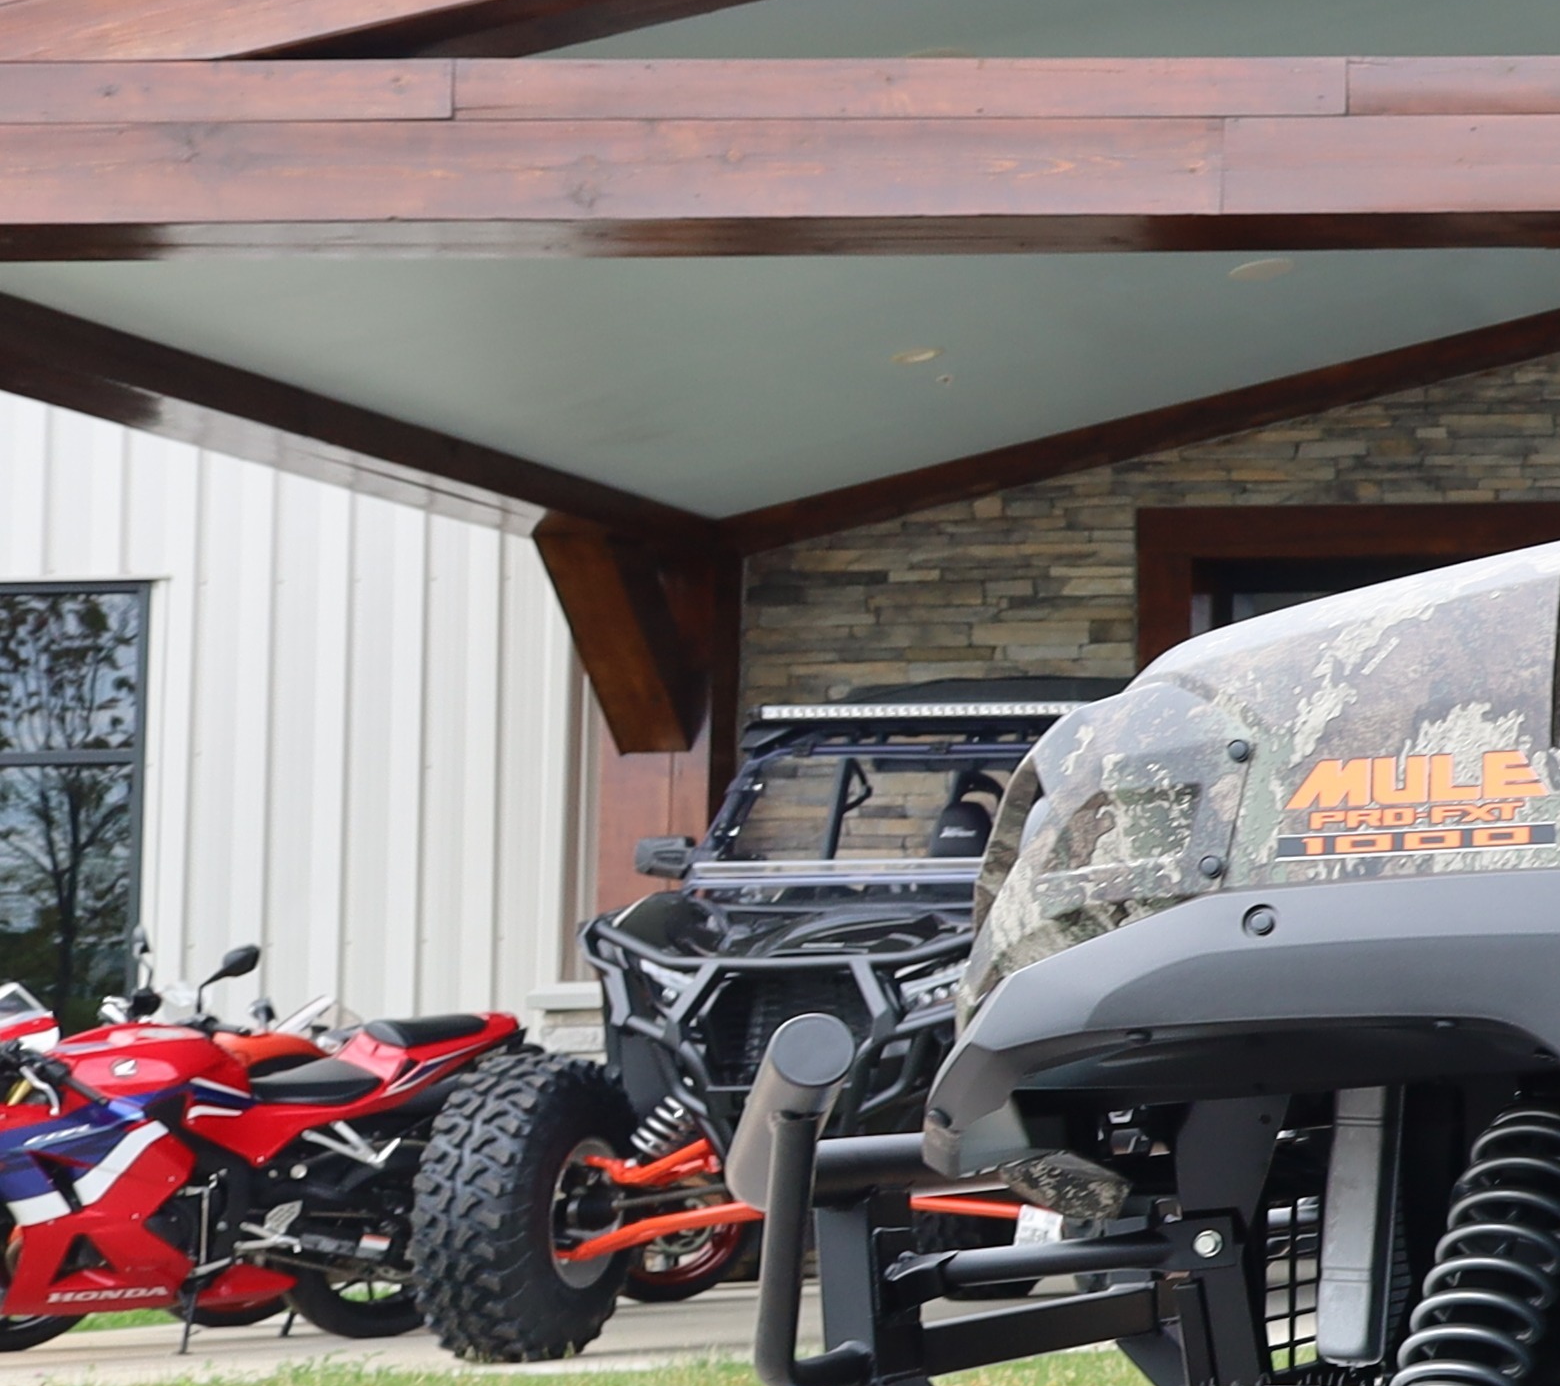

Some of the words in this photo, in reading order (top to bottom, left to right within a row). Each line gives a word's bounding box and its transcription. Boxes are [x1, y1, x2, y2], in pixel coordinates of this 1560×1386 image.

[1284, 750, 1549, 810] MULE
[1309, 801, 1524, 830] PRO-FXT
[1301, 826, 1532, 855] 1000
[47, 1286, 169, 1304] HONDA
